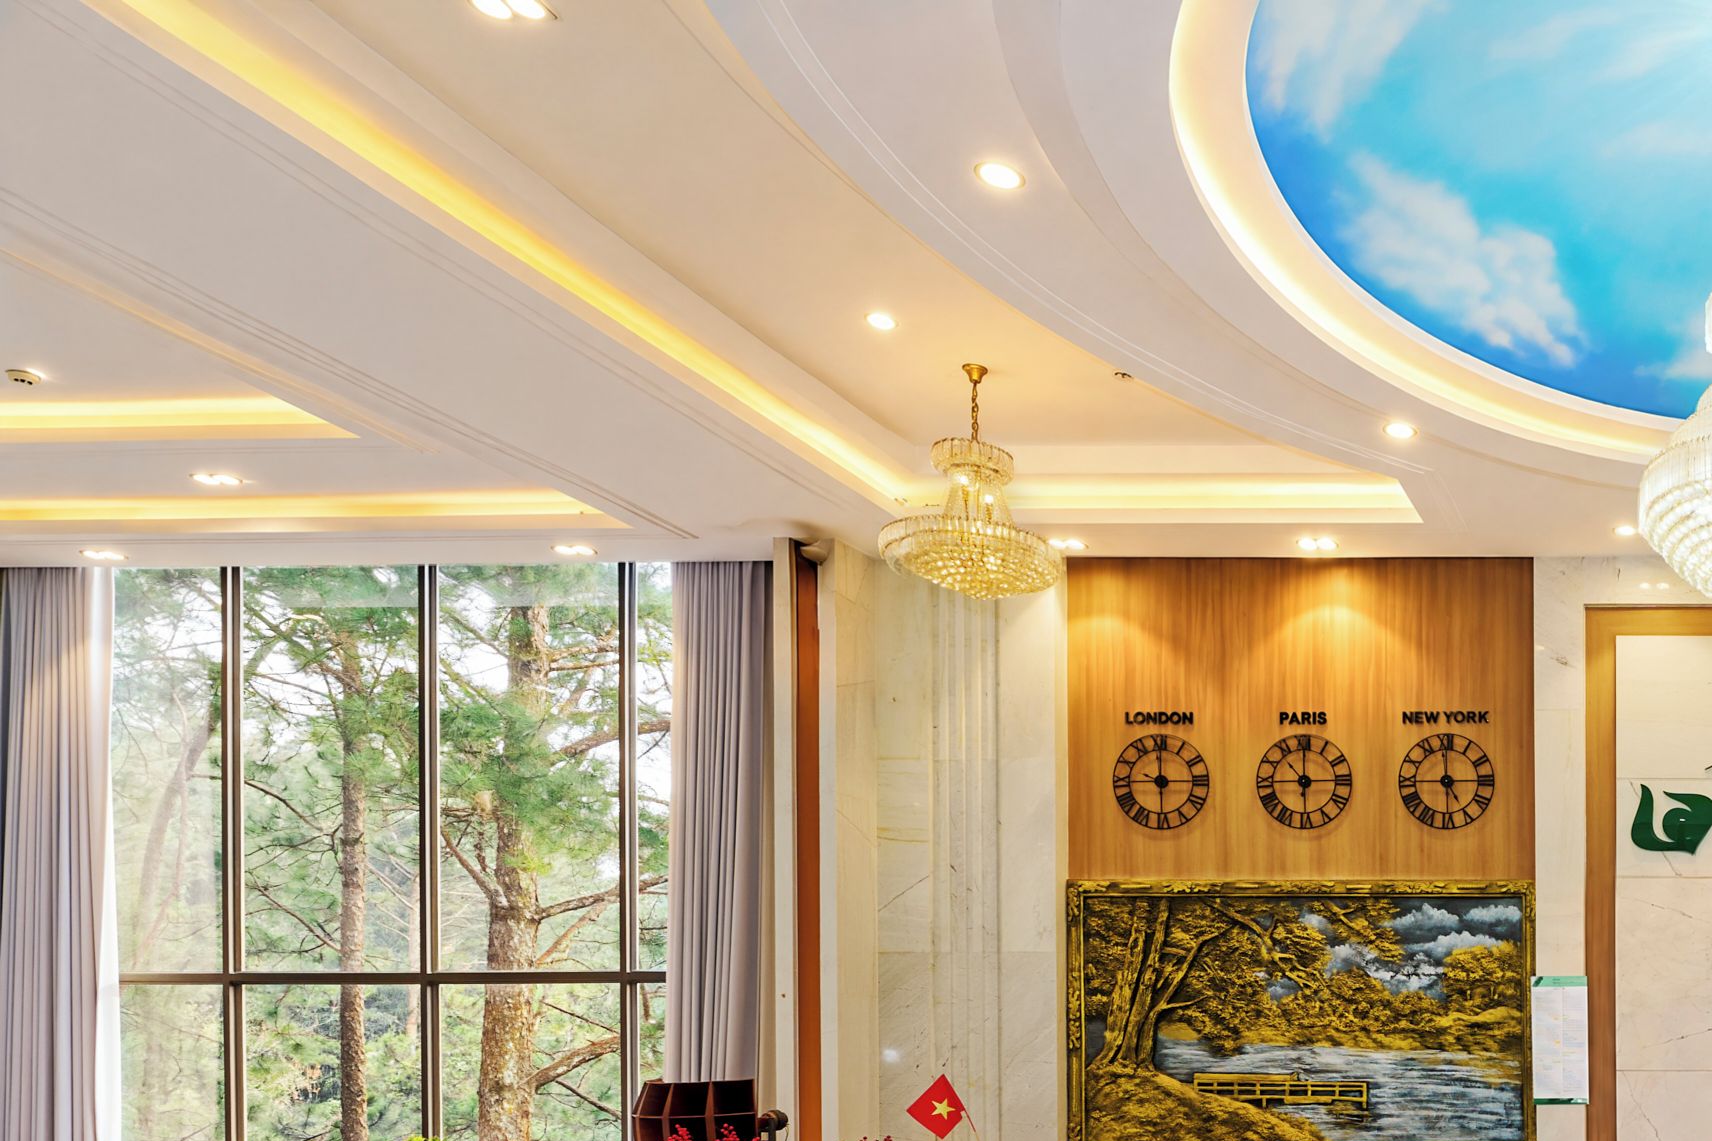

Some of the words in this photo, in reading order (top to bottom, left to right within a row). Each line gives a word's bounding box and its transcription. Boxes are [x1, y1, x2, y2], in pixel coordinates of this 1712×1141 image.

[1125, 711, 1194, 726] LONDON
[1279, 711, 1328, 726] PARIS
[1402, 711, 1440, 725] NEW
[1442, 711, 1490, 725] YORK
